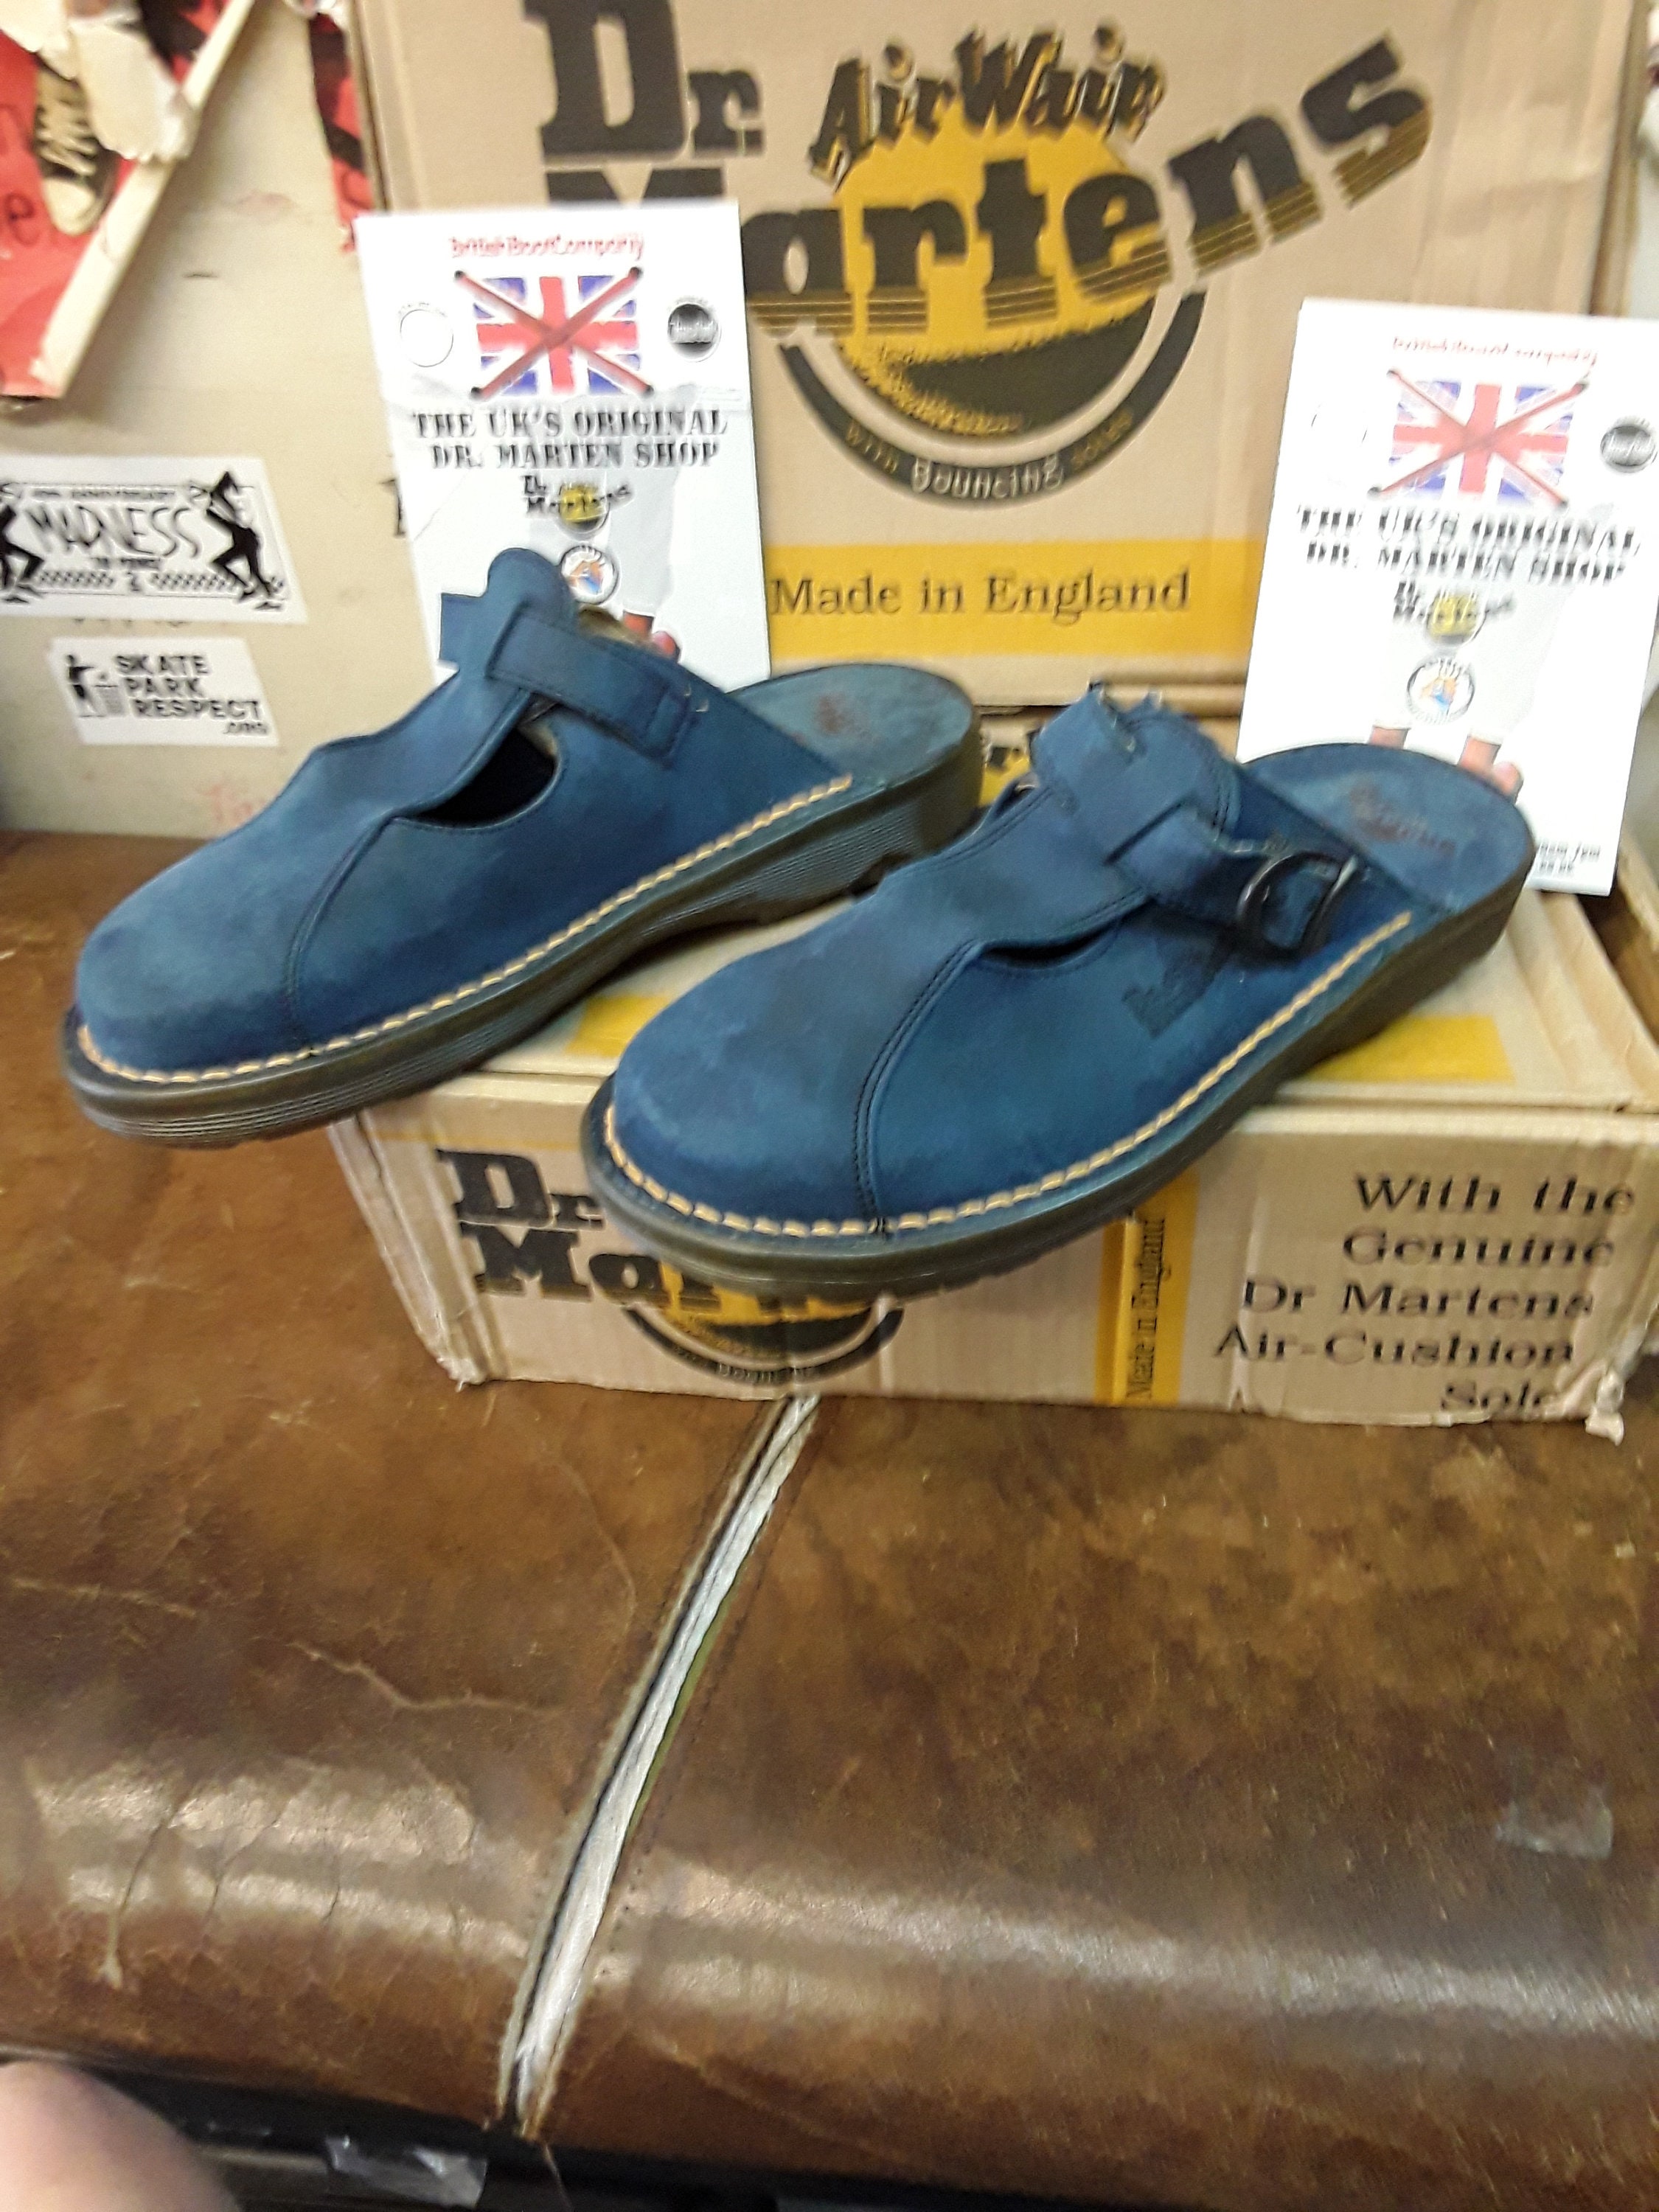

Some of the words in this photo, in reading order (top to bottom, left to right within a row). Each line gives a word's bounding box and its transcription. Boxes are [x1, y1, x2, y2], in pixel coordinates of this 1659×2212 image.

[414, 412, 476, 439] THE
[574, 408, 727, 438] ORIGINAL
[496, 445, 625, 469] MARTEN
[636, 442, 720, 468] SHOP
[770, 570, 901, 616] Made
[919, 572, 965, 614] in
[983, 566, 1192, 625] England
[114, 653, 212, 675] SKATE
[124, 676, 204, 697] PARK
[131, 698, 260, 719] RESPECT
[1353, 1173, 1503, 1215] With
[1531, 1173, 1636, 1216] the
[1341, 1226, 1616, 1268] Genuine
[1242, 1276, 1318, 1314] Dr
[1340, 1281, 1595, 1320] Martens
[1213, 1326, 1575, 1368] Air-Cushion
